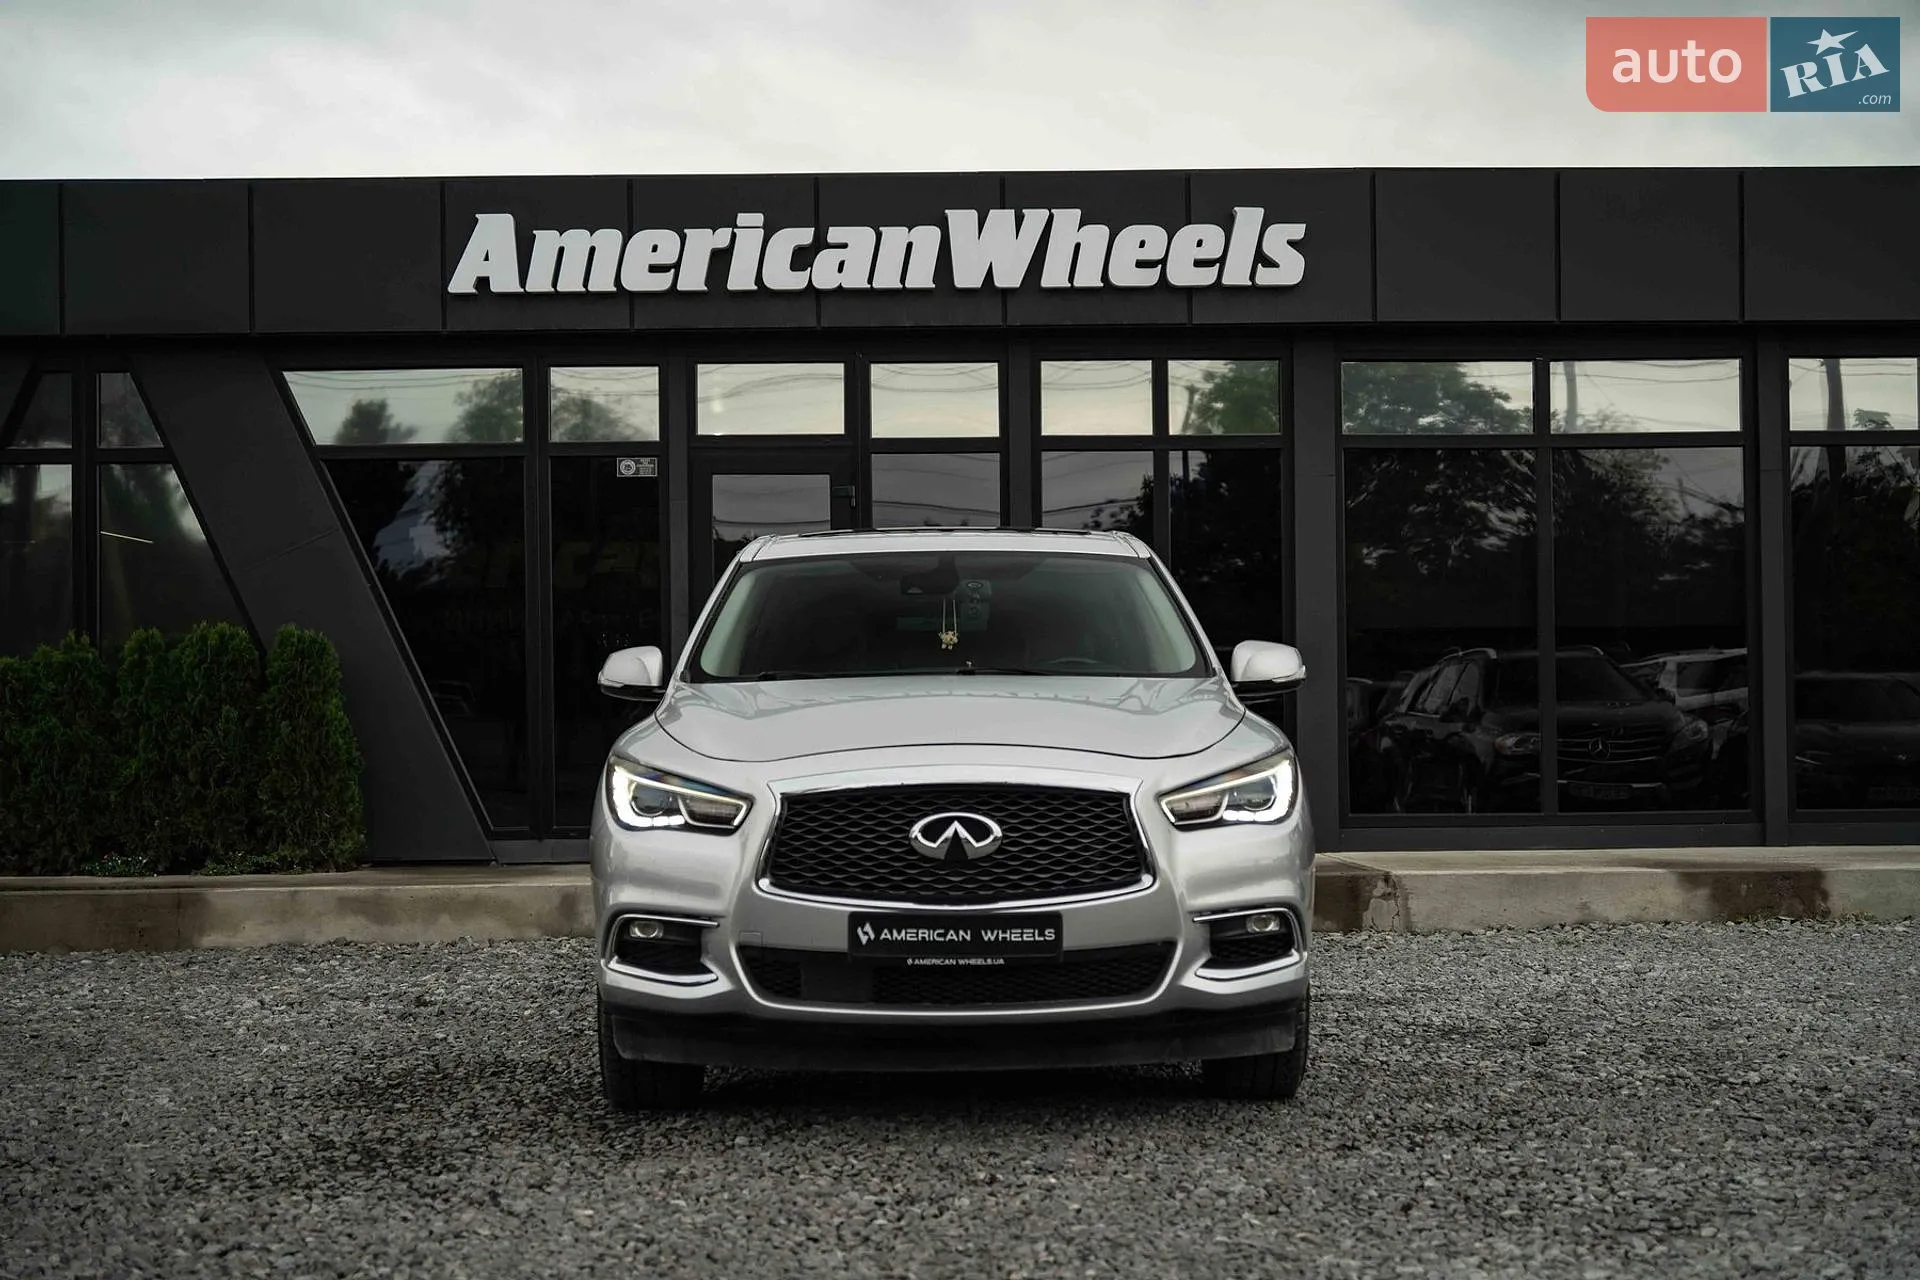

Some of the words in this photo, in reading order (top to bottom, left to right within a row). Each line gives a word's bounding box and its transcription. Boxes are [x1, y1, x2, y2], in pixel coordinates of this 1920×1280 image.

[447, 206, 1307, 295] AmericanWheels
[879, 928, 971, 942] AMERICAN
[981, 928, 1056, 942] WHEELS
[913, 958, 957, 966] AMERICAN
[957, 958, 1005, 966] WHEELS.UA
